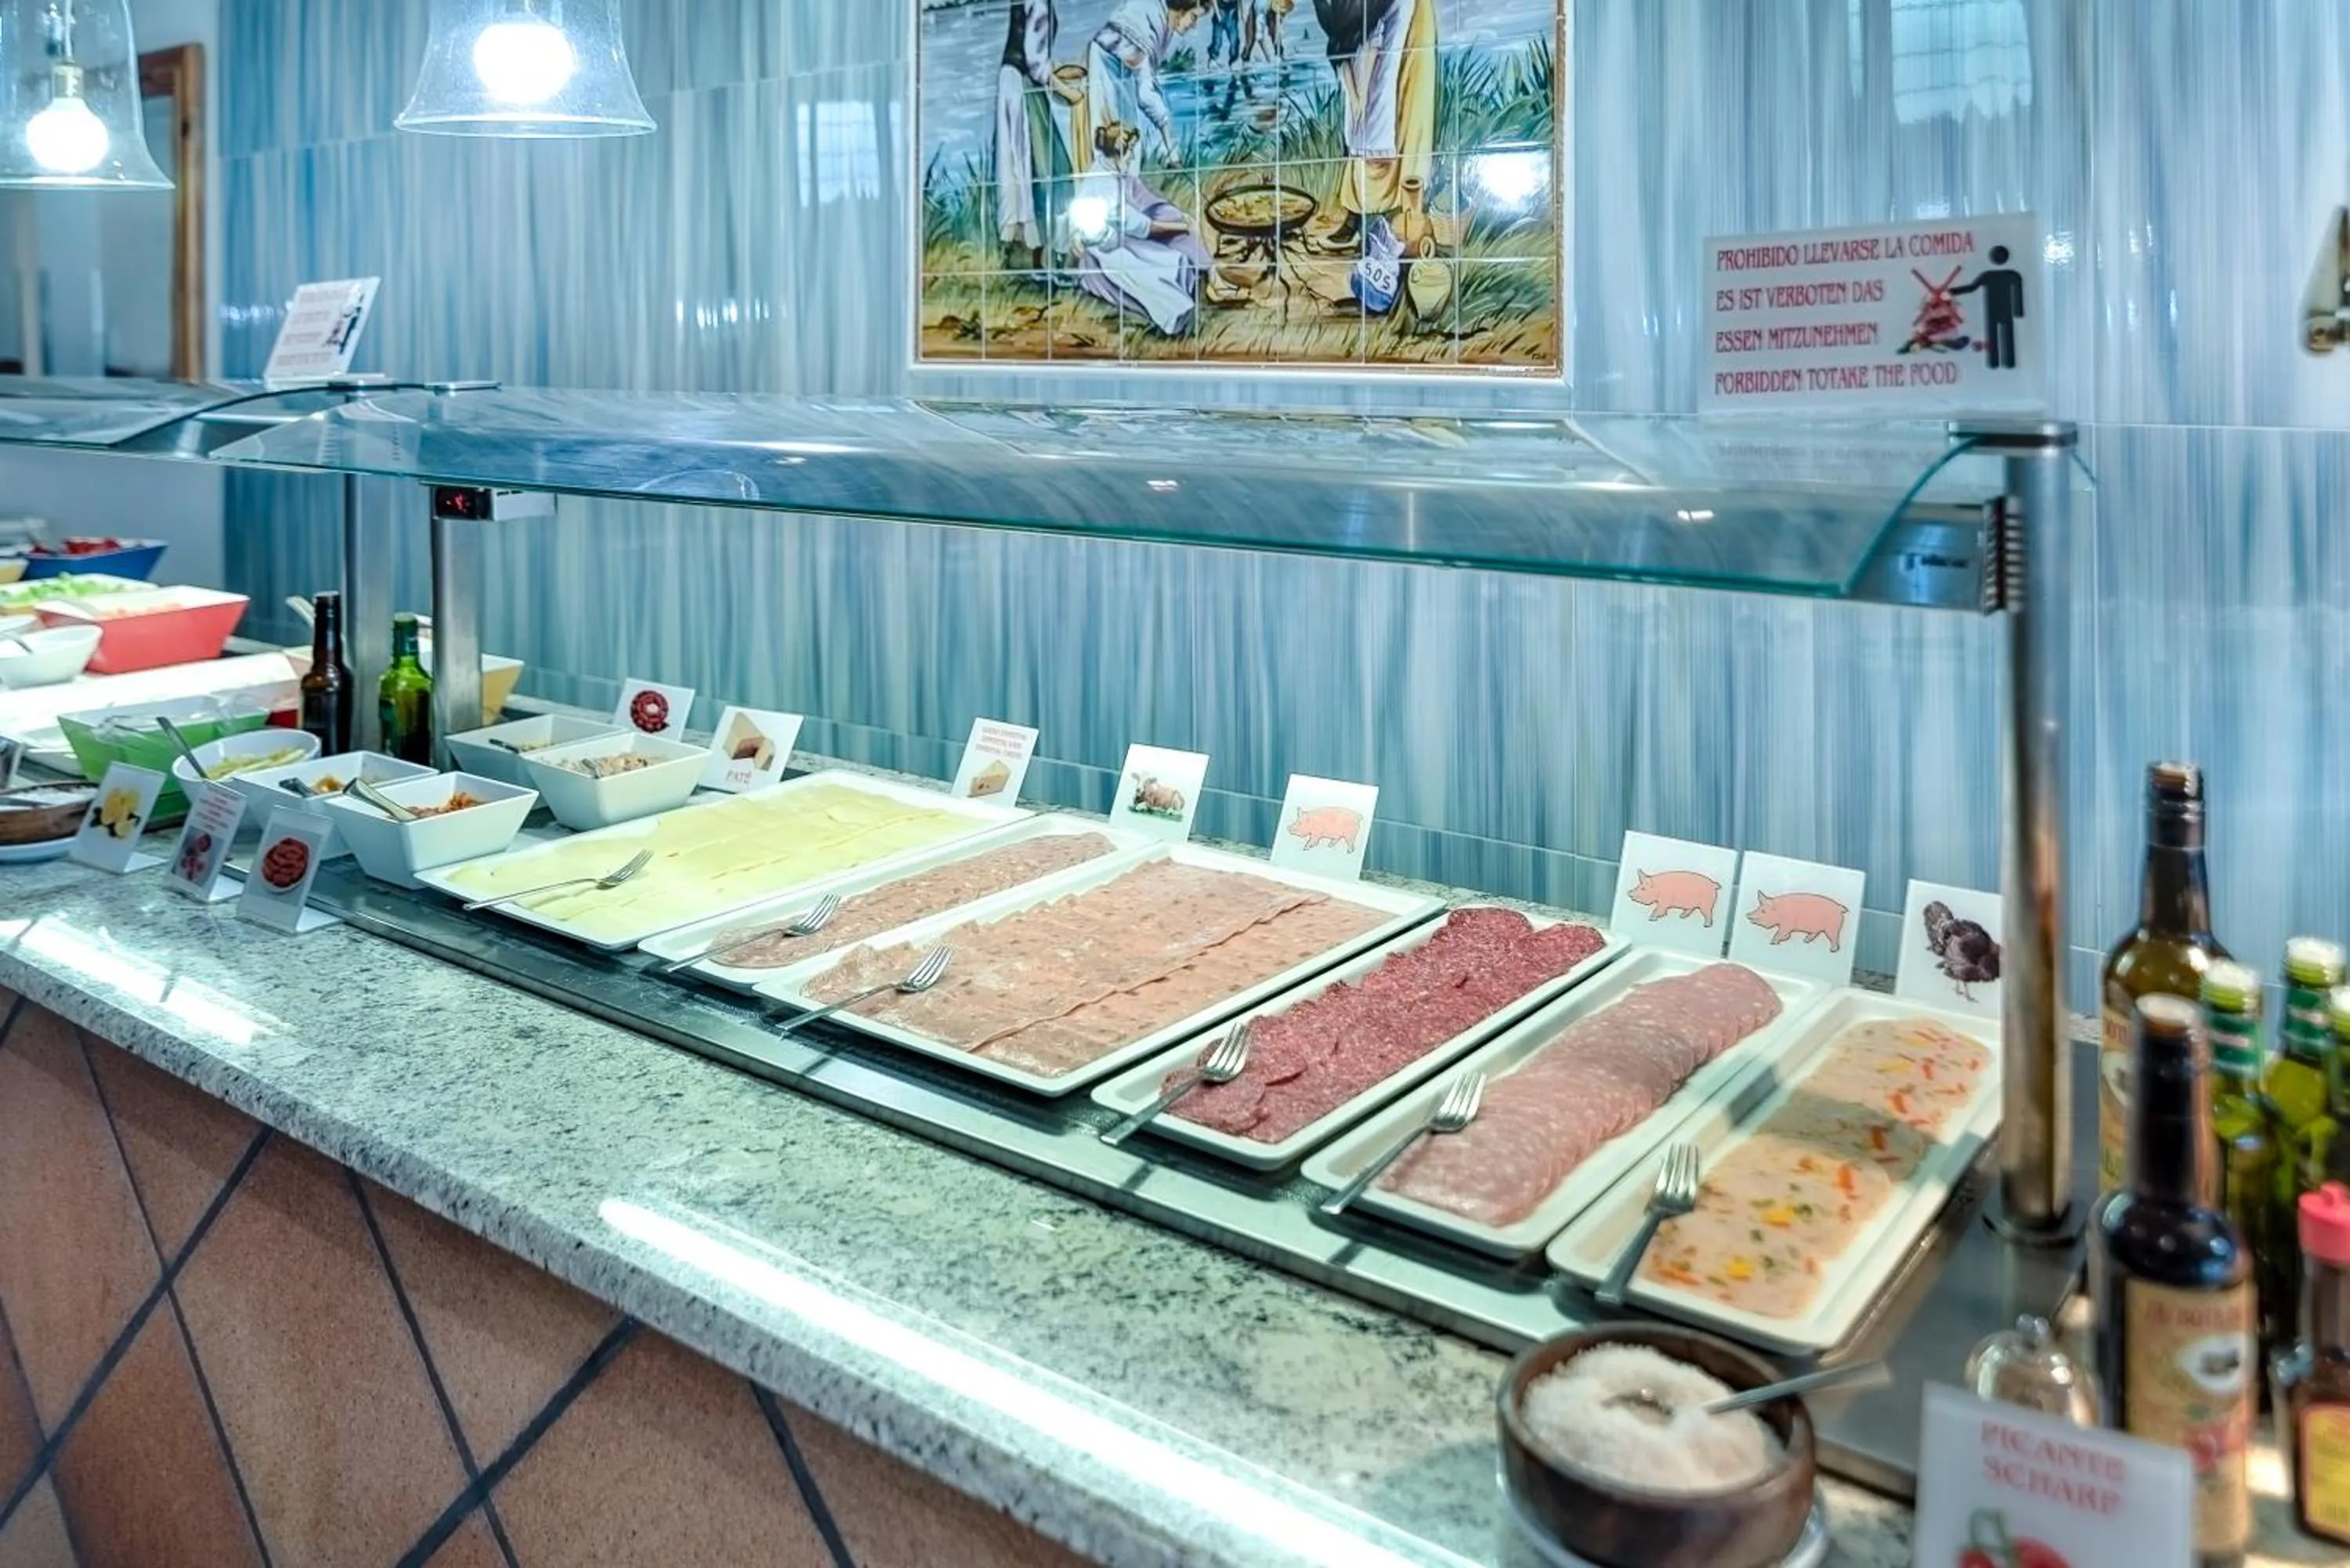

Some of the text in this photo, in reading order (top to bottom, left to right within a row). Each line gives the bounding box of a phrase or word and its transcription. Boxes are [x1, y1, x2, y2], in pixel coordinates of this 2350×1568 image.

[1716, 231, 1975, 271] PROHIBIDO LLEVARSE LA COMIDA
[1716, 279, 1885, 312] ES IST VERBOTEN DAS
[1716, 322, 1878, 352] ESSEN MITZUNEHMEN
[1715, 369, 1802, 396] FORBIDDEN
[1873, 364, 1905, 388] THE
[1910, 361, 1958, 387] FOOD
[1981, 1419, 2125, 1481] PICANTE
[1983, 1454, 2122, 1515] SCHARF
